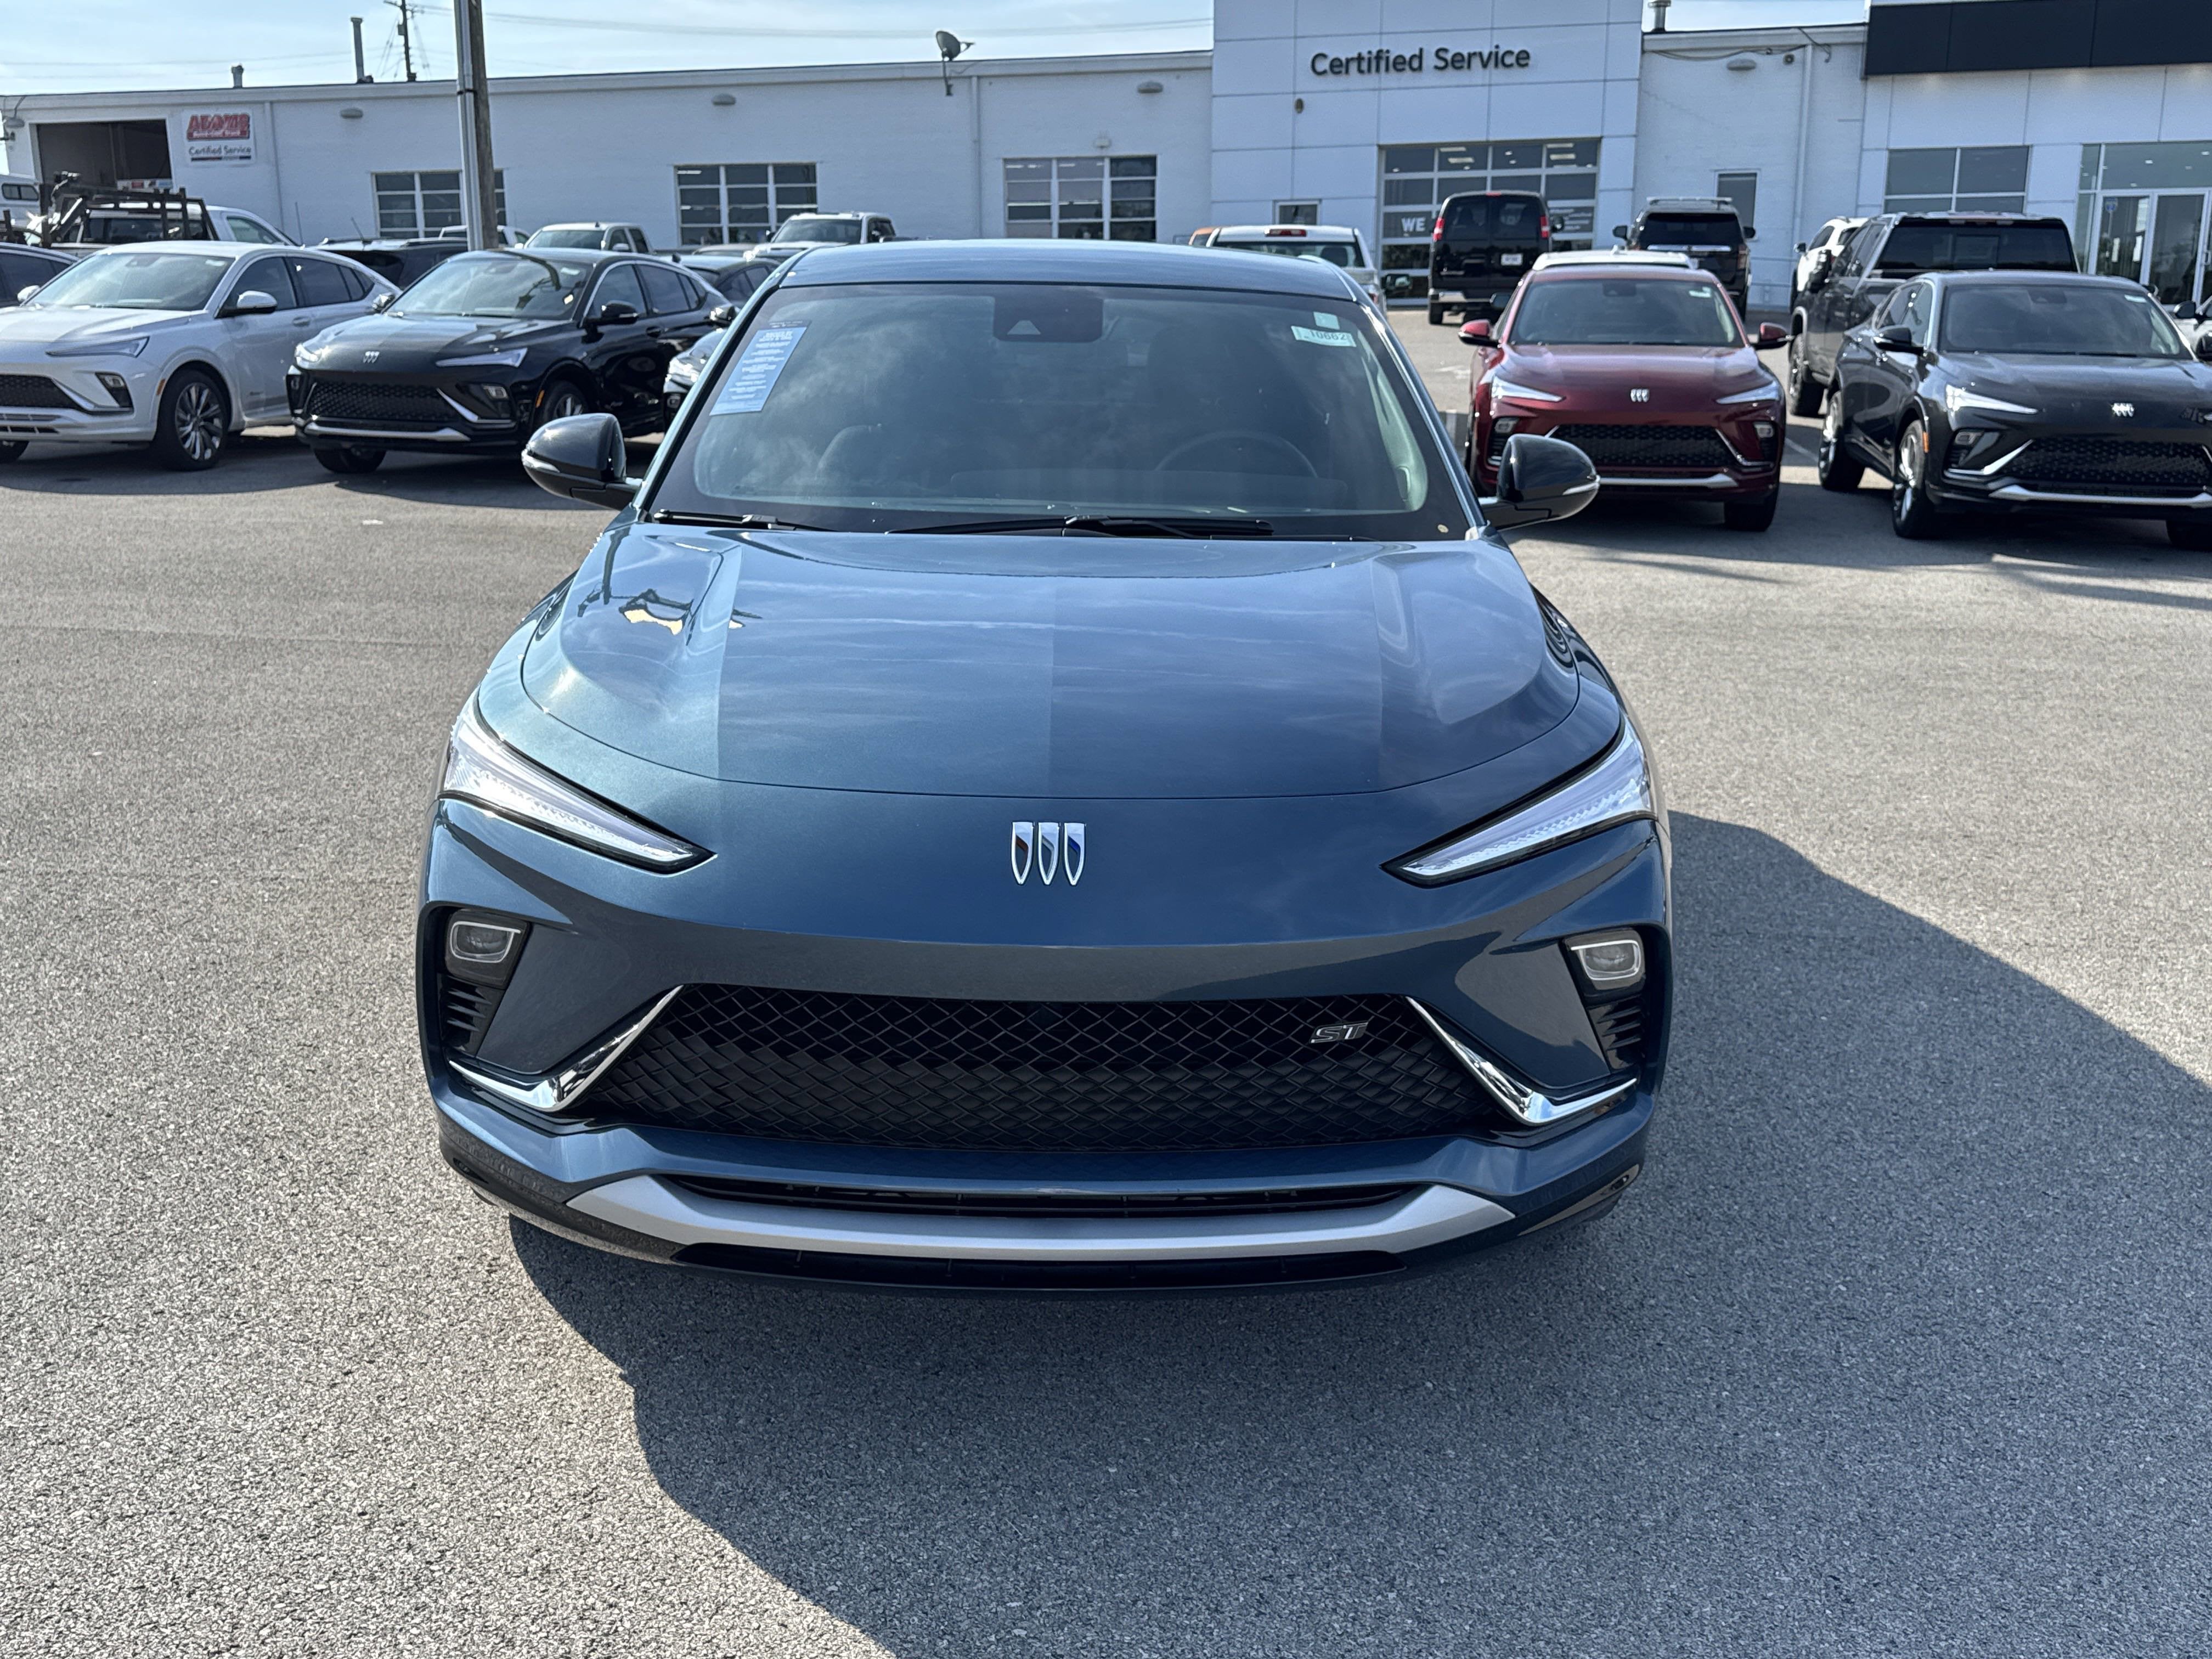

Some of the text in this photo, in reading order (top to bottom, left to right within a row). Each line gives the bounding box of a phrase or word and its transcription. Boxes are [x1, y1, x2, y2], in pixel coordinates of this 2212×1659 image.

[1310, 44, 1531, 76] Certified Service
[1401, 217, 1426, 232] WE
[1310, 1022, 1369, 1043] ST
